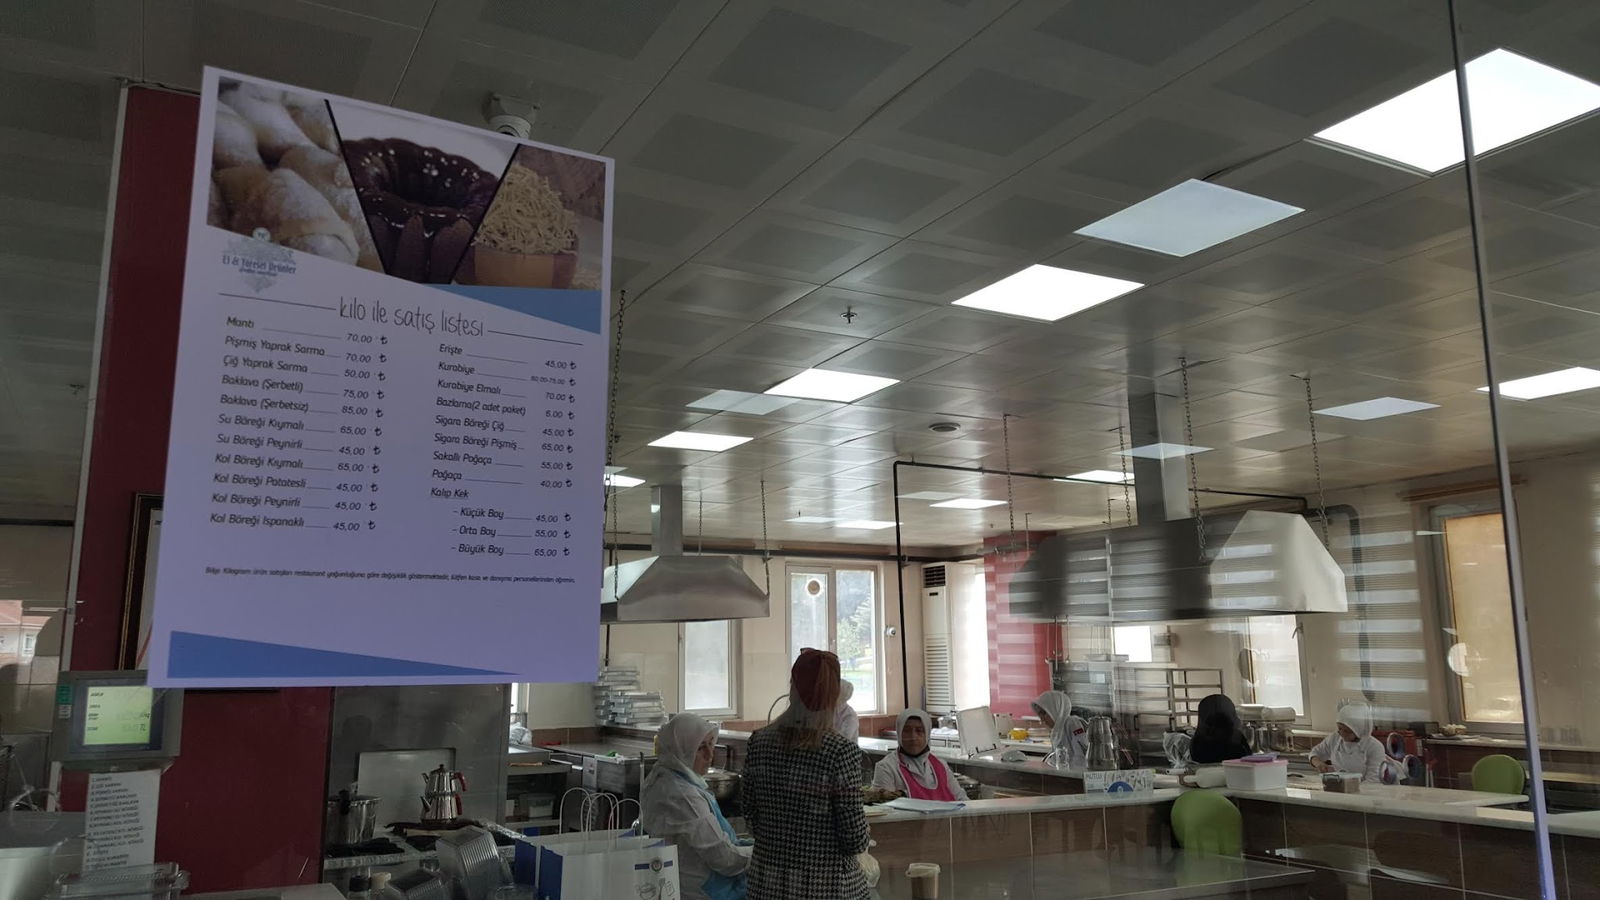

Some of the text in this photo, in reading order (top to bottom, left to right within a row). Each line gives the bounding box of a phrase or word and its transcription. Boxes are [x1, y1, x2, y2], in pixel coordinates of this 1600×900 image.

[261, 342, 291, 352] Yaprak
[295, 346, 325, 356] Sarma
[439, 344, 463, 355] Erişte
[243, 359, 273, 370] Yaprak
[278, 361, 308, 373] Sarma
[438, 362, 475, 375] Kurabiye
[222, 375, 259, 387] Baklava
[438, 379, 474, 392] Kurabiye
[476, 384, 501, 394] Elmalı
[220, 395, 257, 407] Baklava
[482, 403, 500, 413] adet
[502, 405, 526, 416] paket)
[218, 414, 231, 424] Su
[234, 415, 265, 428] Böreği
[268, 419, 304, 431] Kıymalı
[435, 415, 461, 427] Sigara
[464, 418, 489, 430] Böreği
[216, 434, 229, 443] Su
[233, 435, 264, 448] Böreği
[267, 438, 302, 450] Peynirli
[434, 433, 460, 444] Sigara
[463, 436, 488, 448] Böreği
[215, 454, 230, 463] Kol
[234, 455, 264, 468] Böreği
[268, 458, 303, 470] Kıymalı
[214, 473, 229, 483] Kol
[232, 474, 262, 488] Böreği
[266, 477, 306, 488] Patatesli
[454, 489, 469, 498] Kek
[212, 493, 228, 503] Kol
[230, 494, 261, 507] Böreği
[264, 497, 300, 509] Peynirli
[210, 513, 225, 524] Kol
[229, 514, 260, 527] Böreği
[460, 507, 485, 518] Küçük
[488, 509, 504, 520] Boy
[459, 526, 477, 536] Orta
[480, 527, 496, 538] Boy
[459, 544, 485, 555] Büyük
[488, 545, 504, 556] Boy
